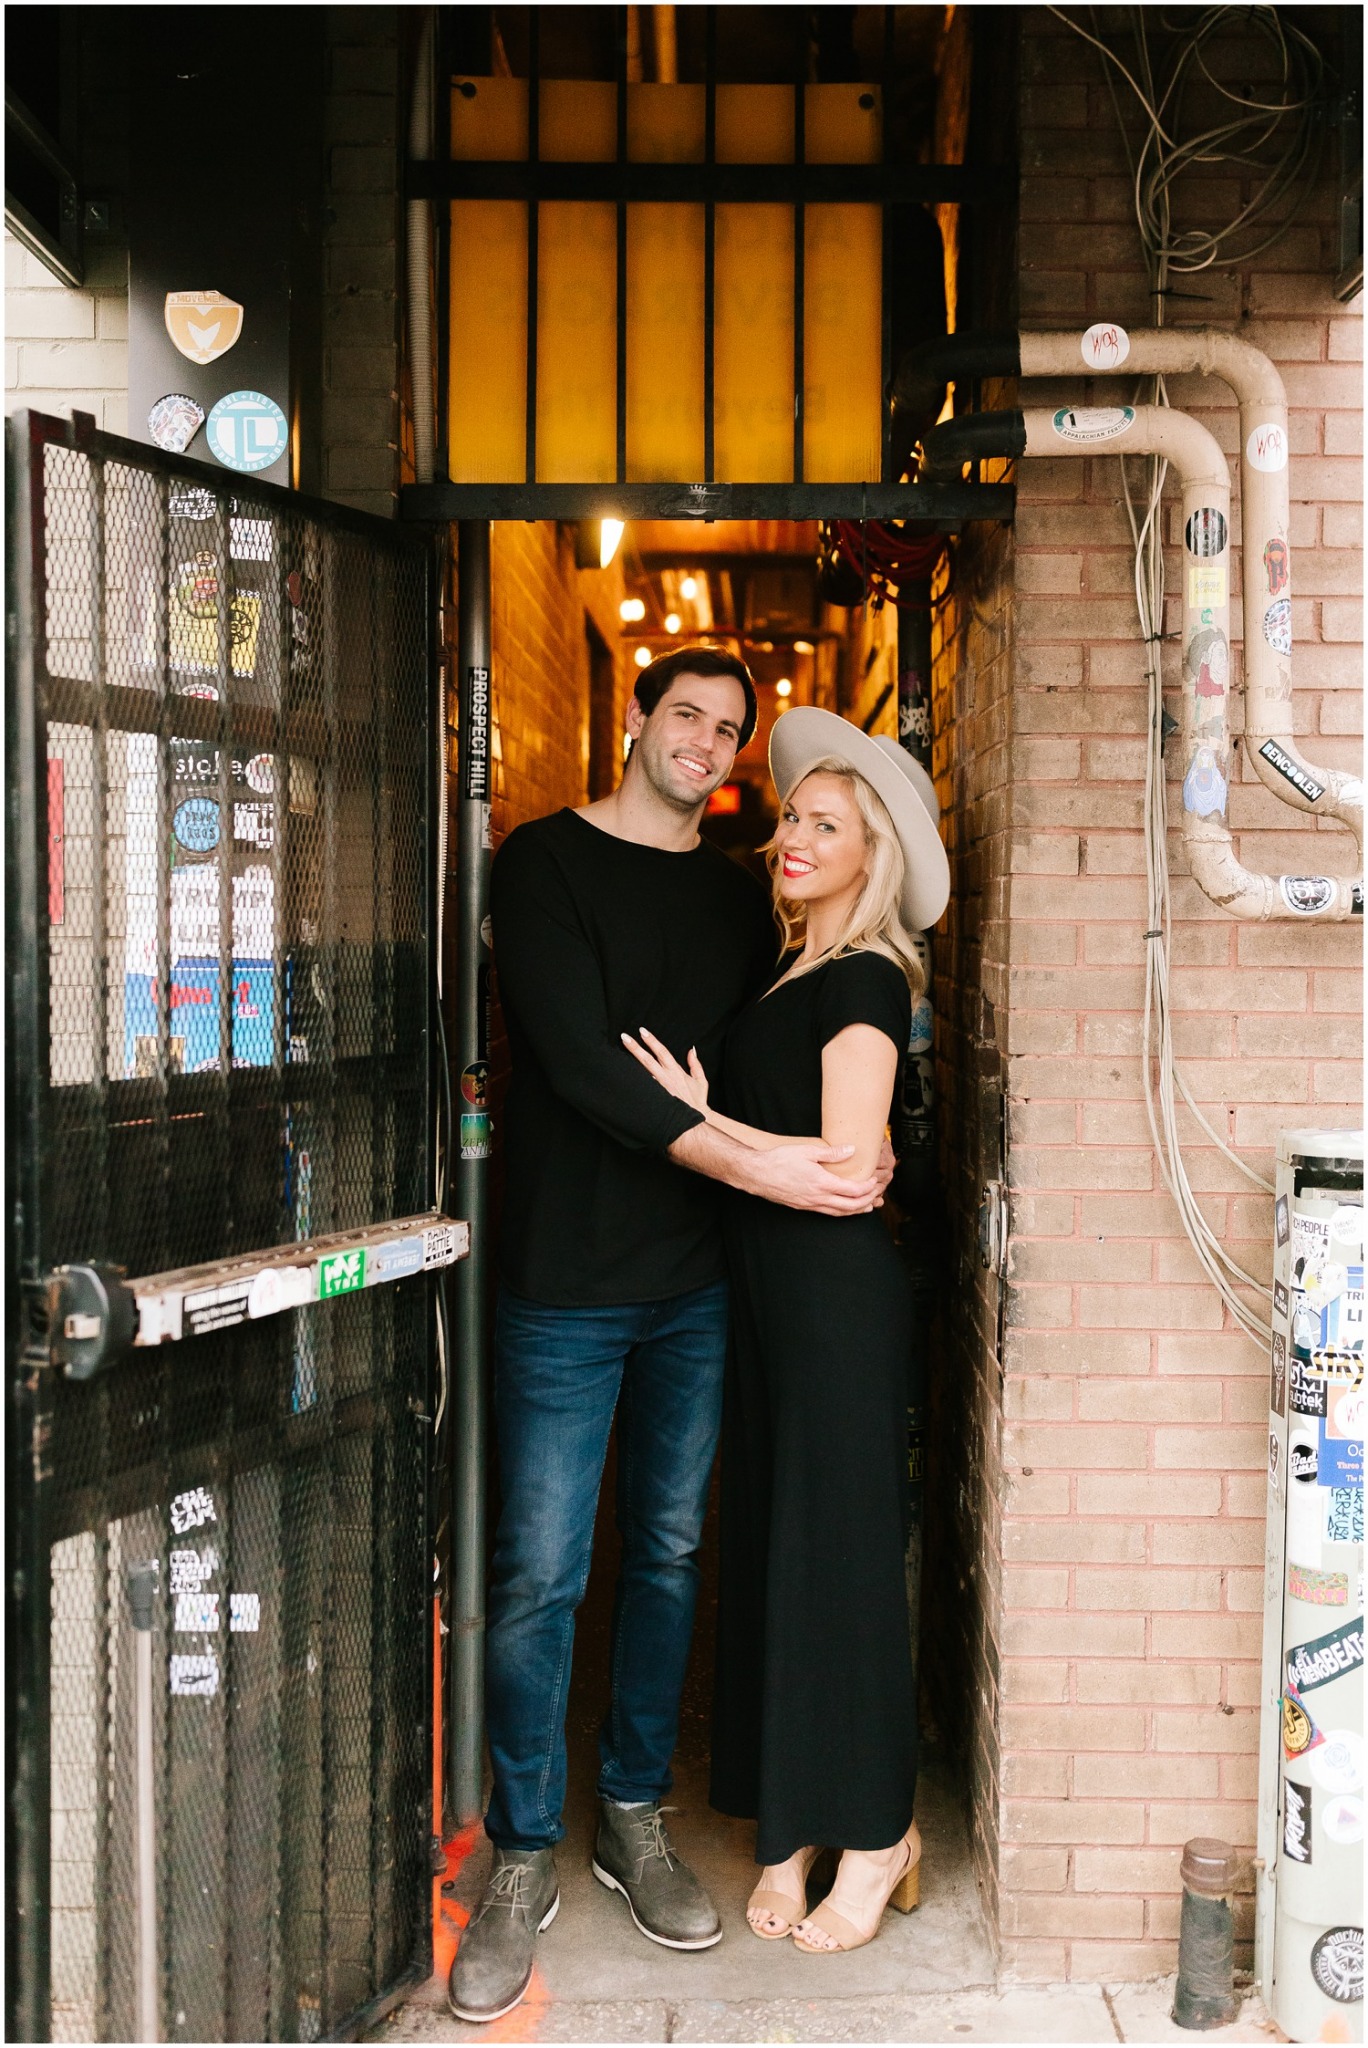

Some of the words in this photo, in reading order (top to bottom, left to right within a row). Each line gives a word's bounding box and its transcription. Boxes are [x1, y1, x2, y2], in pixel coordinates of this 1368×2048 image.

[249, 392, 285, 422] LISTED
[1062, 429, 1106, 440] APPALACHIAN
[1107, 419, 1128, 435] FERNET
[472, 669, 489, 758] PROSPECT
[470, 760, 487, 798] HILL
[1261, 742, 1322, 801] BENCOOLEN
[1301, 1220, 1330, 1237] PEOPLE
[427, 1235, 450, 1254] PATTIE
[1290, 1389, 1324, 1408] subtek
[1336, 1461, 1360, 1470] Three
